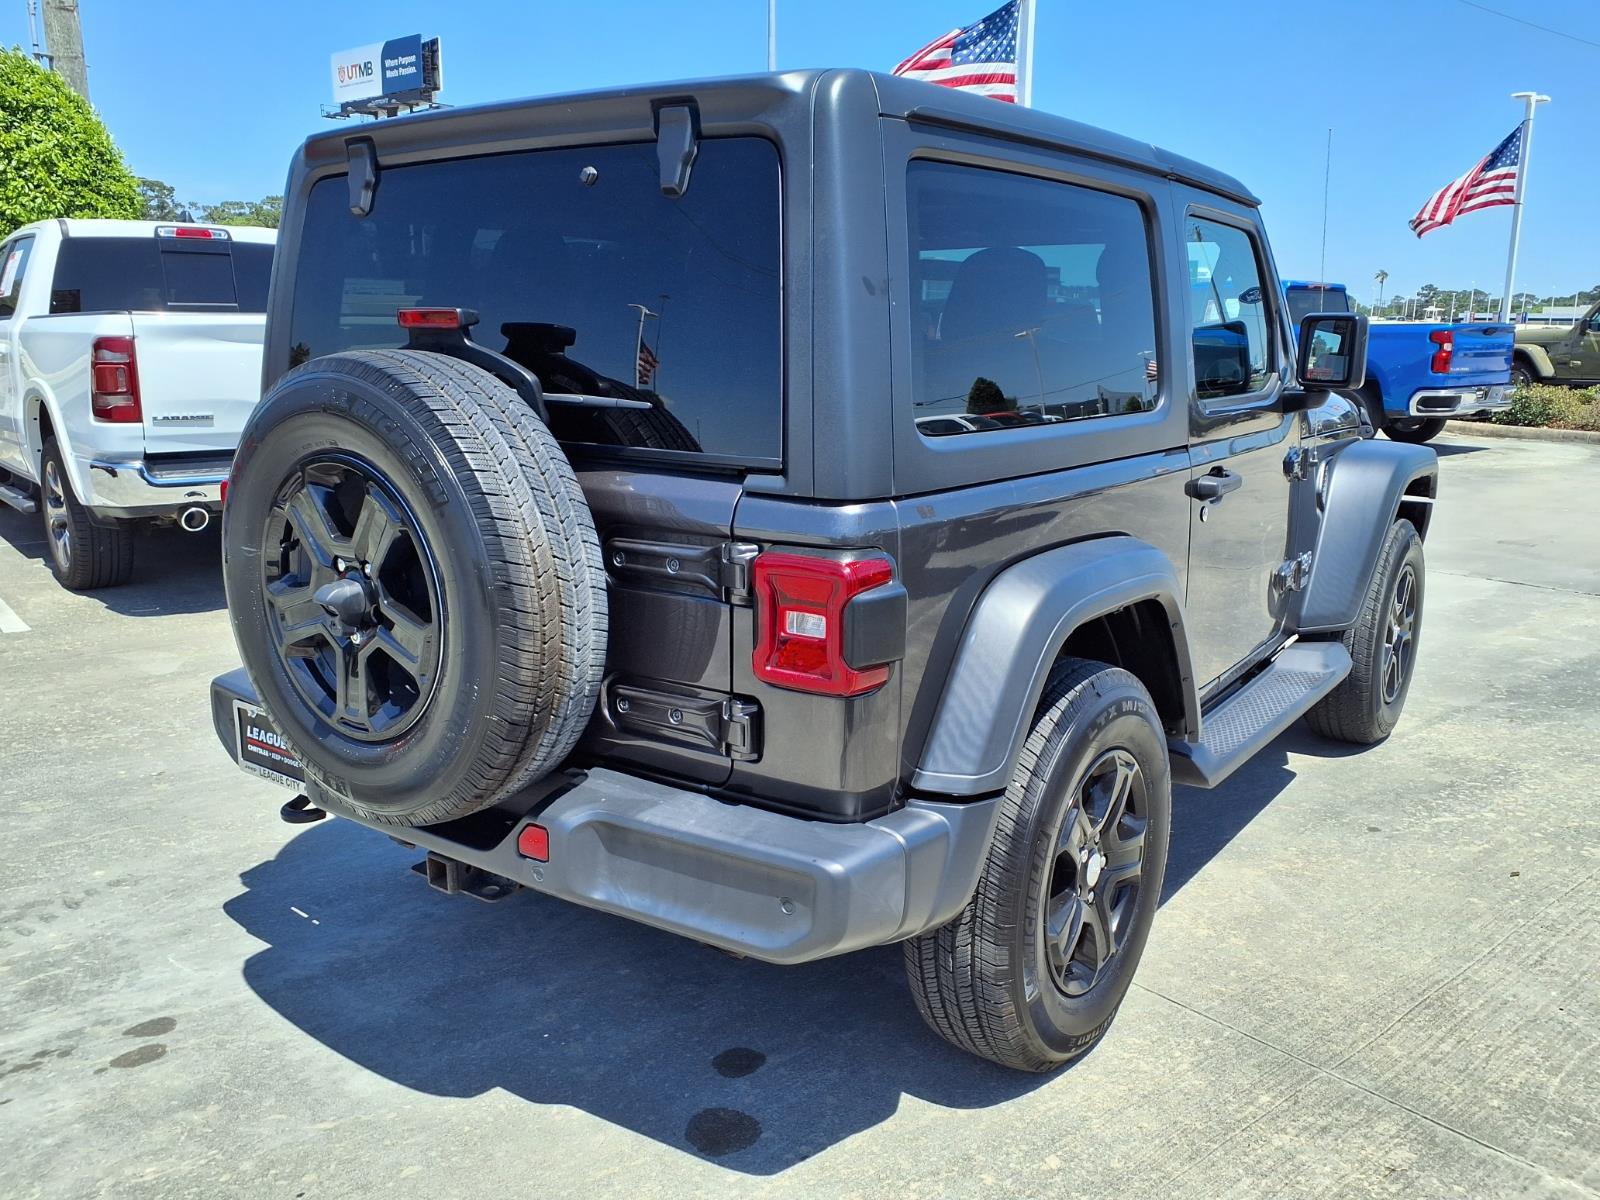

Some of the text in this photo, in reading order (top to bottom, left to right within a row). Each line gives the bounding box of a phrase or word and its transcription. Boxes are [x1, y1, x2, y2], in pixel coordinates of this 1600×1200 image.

[347, 61, 373, 80] UTMB
[385, 55, 416, 67] Where Purpose
[247, 725, 287, 749] LEAGUE
[260, 769, 284, 785] LEAGUE
[286, 778, 300, 791] CITY
[1023, 828, 1052, 968] MICHELIN
